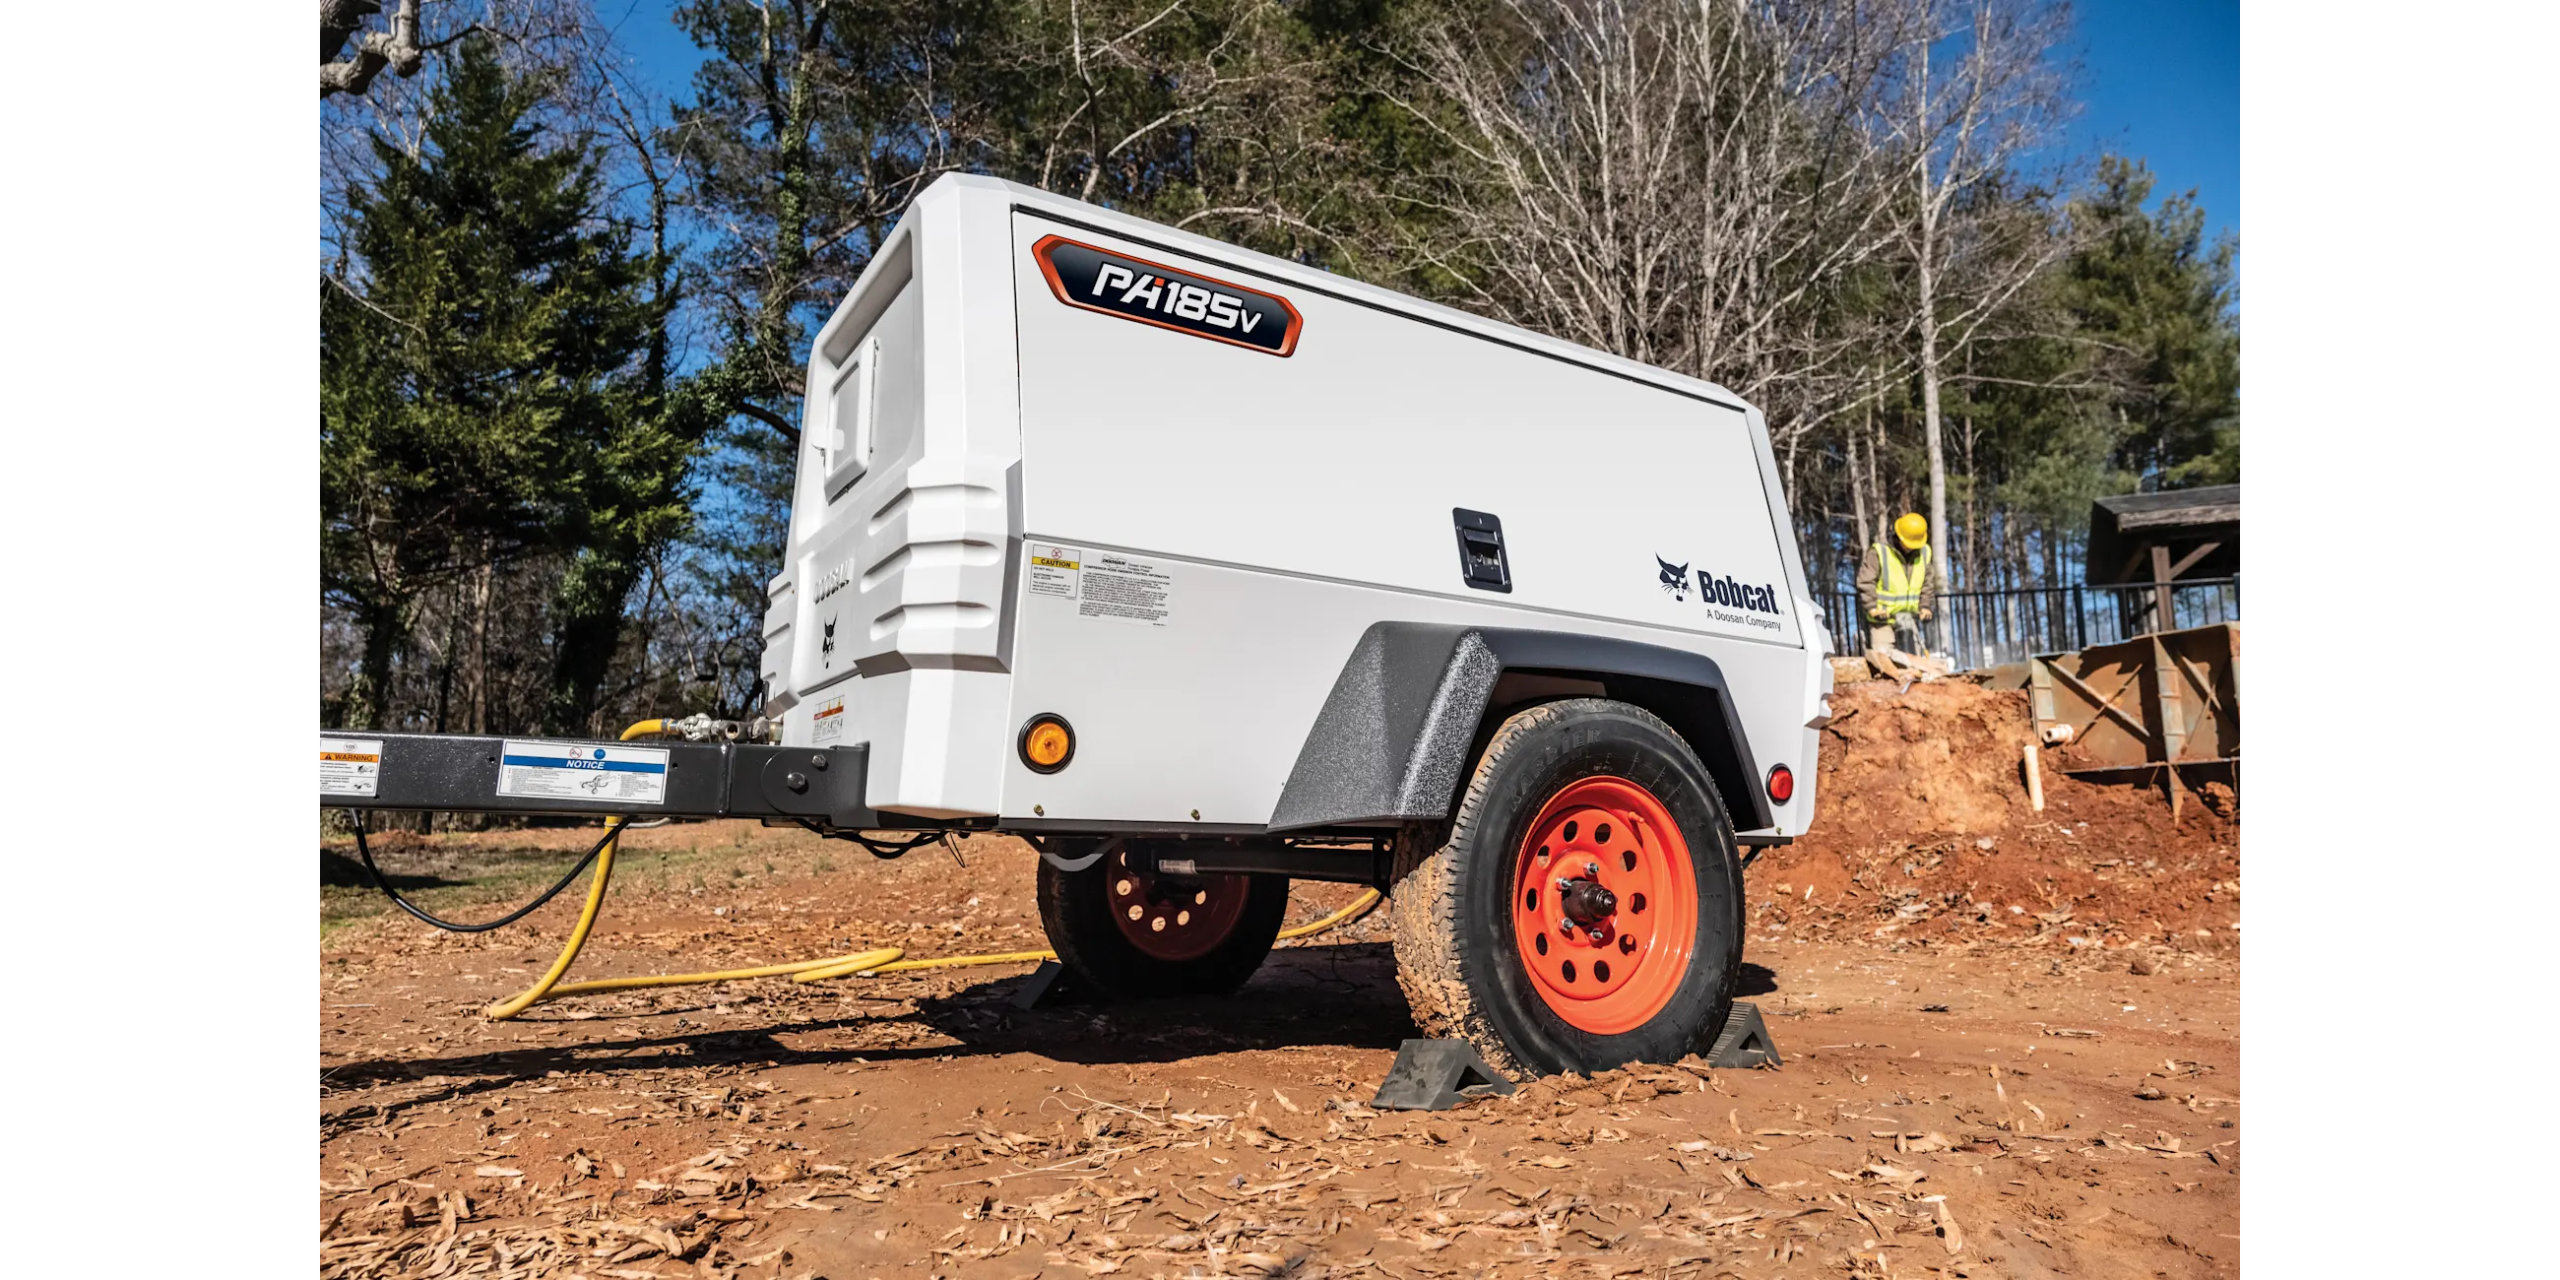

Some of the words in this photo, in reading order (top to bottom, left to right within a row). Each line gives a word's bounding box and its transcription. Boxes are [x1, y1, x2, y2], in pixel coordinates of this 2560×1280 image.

[1041, 558, 1071, 568] CAUTION
[1697, 570, 1779, 615] Bobcat
[1707, 609, 1713, 619] A
[1714, 610, 1744, 624] Doosan
[1746, 615, 1781, 632] Company
[335, 754, 373, 762] WARNING
[566, 760, 605, 770] NOTICE
[1506, 728, 1601, 812] KARRIER
